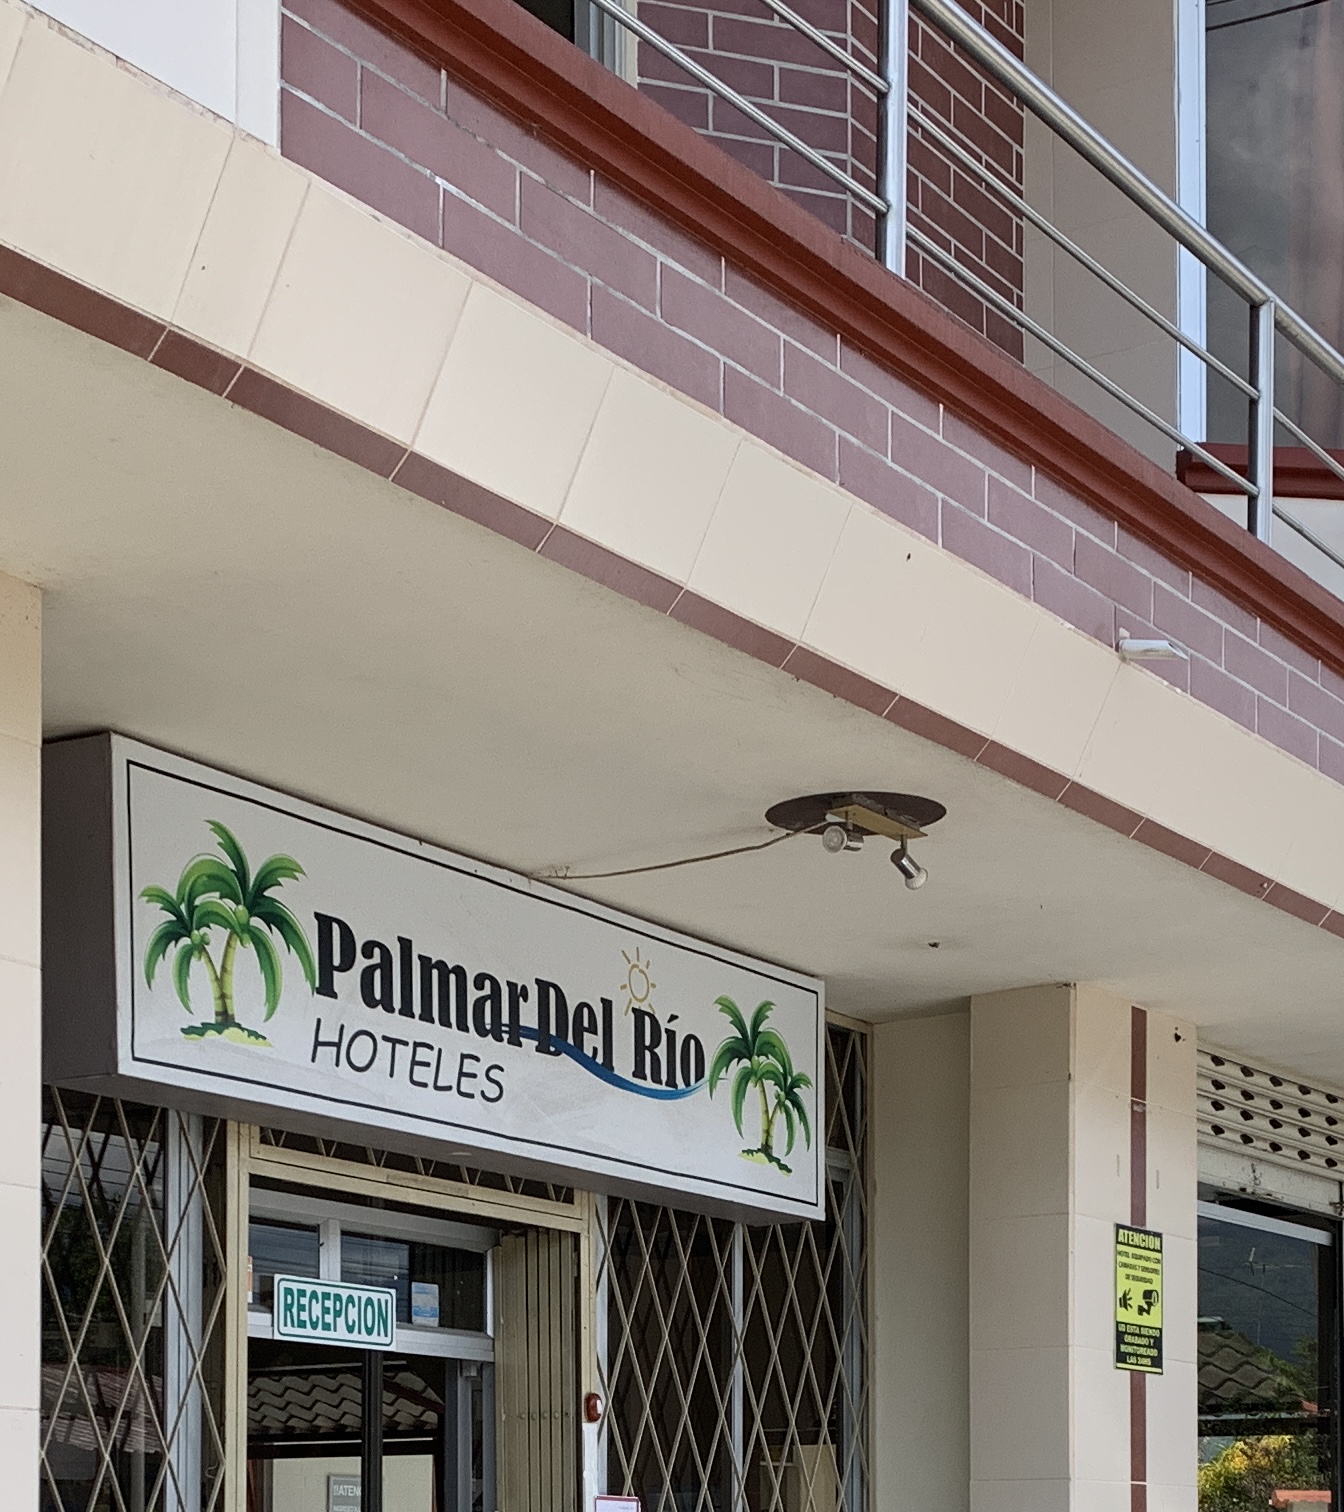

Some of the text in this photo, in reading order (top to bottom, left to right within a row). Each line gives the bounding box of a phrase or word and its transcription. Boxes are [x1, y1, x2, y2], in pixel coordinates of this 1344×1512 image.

[311, 1018, 505, 1103] HOTELES
[632, 1007, 706, 1090] Río
[1118, 1229, 1161, 1250] ATENCION
[283, 1287, 388, 1337] RECEPCION
